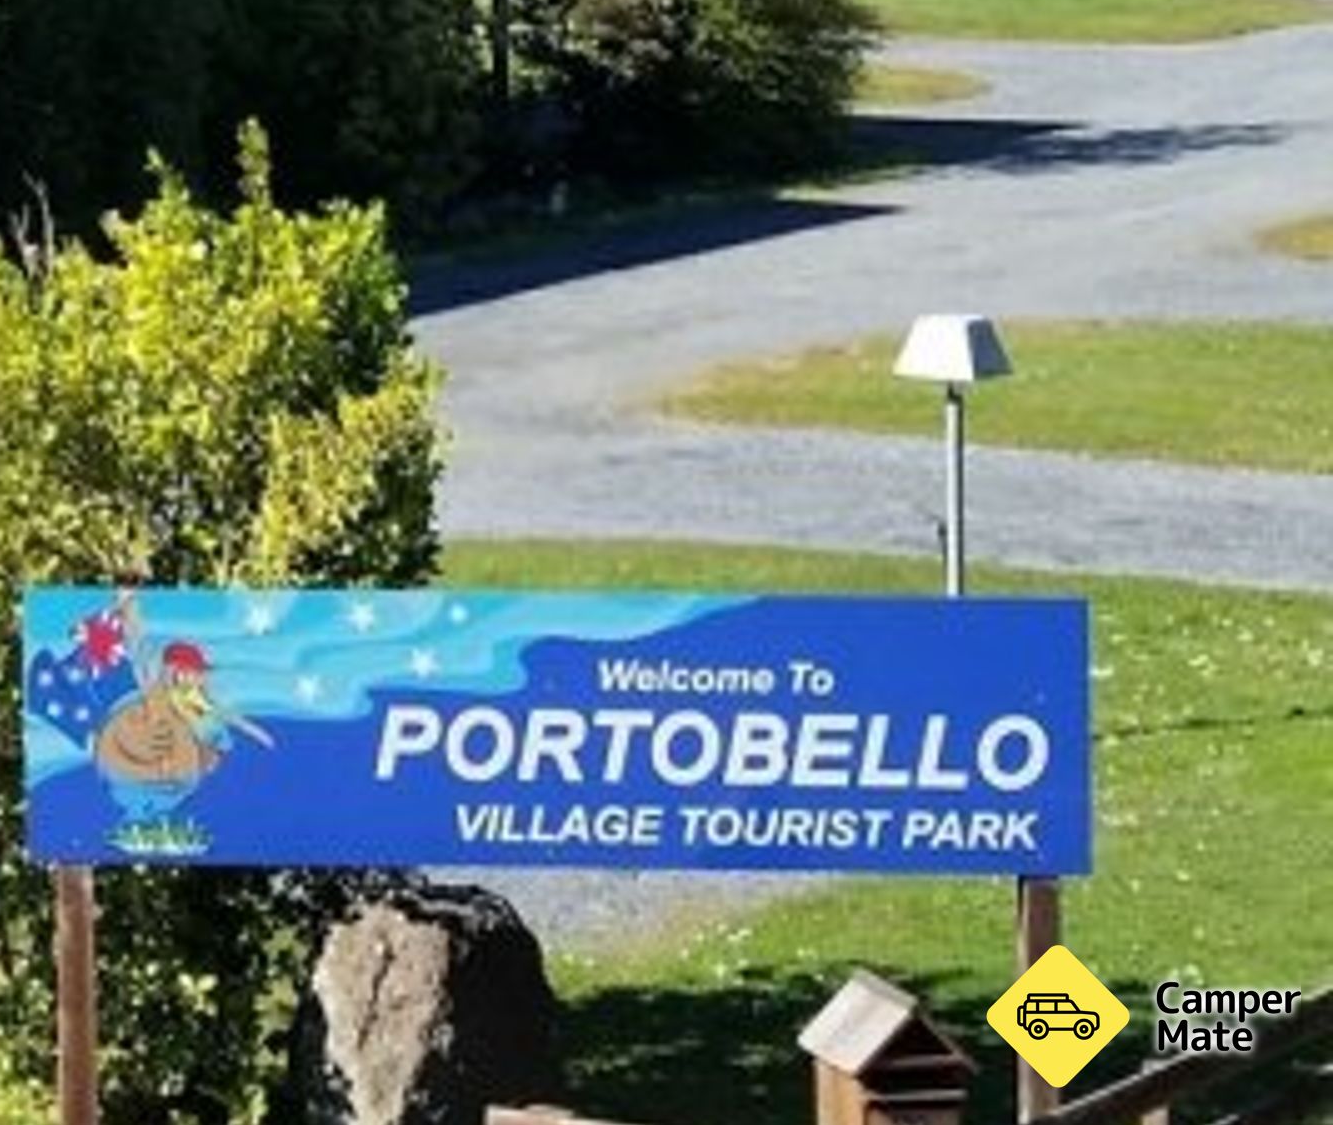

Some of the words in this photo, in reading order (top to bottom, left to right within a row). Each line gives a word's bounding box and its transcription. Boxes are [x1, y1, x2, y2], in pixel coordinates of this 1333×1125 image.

[598, 660, 775, 694] Welcome
[789, 662, 834, 695] To
[376, 706, 1049, 791] PORTOBELLO
[456, 804, 664, 844] VILLAGE
[680, 807, 892, 848] TOURIST
[902, 810, 1038, 850] PARK
